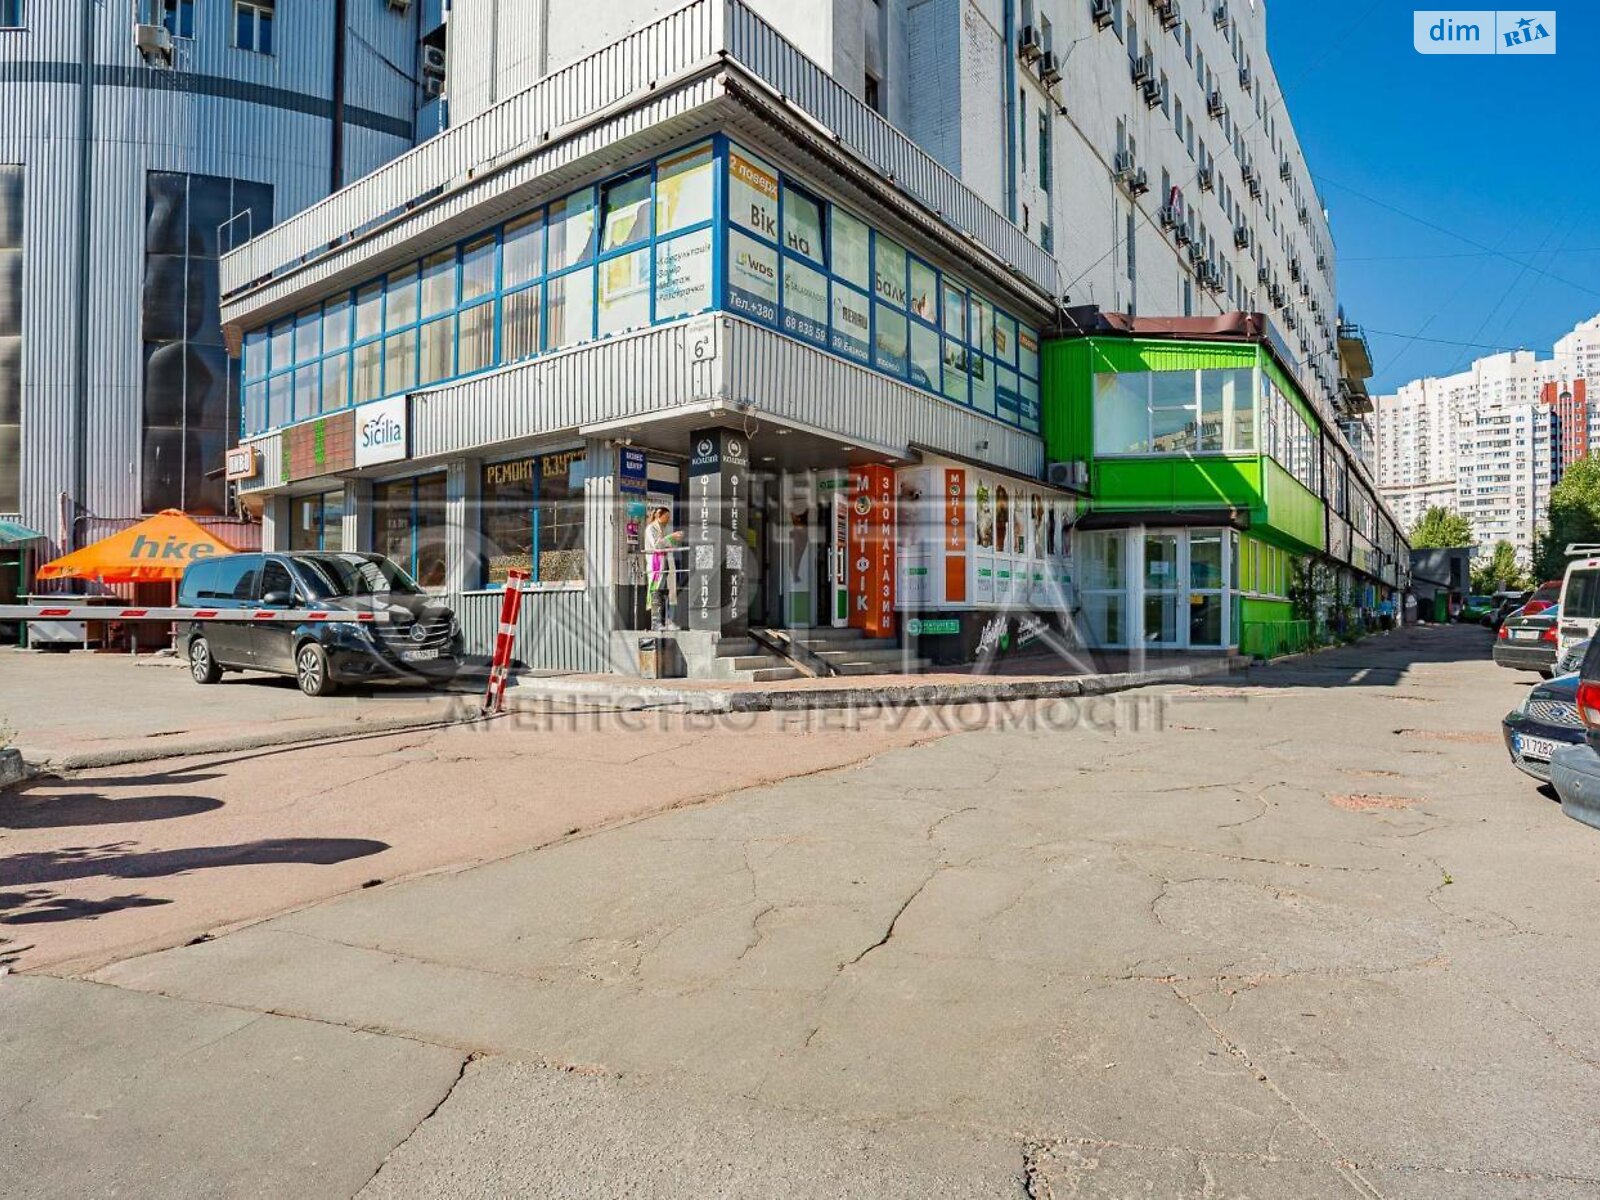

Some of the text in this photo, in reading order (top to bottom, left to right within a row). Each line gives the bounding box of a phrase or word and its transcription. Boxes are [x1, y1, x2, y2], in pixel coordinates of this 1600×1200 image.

[785, 315, 796, 330] 68
[362, 420, 402, 448] Sicilia
[487, 460, 534, 484] РЕМОНТ
[700, 475, 709, 618] ФІТНЕС КЛУБ
[730, 475, 739, 618] ФІТНЕС КЛУБ
[882, 477, 890, 629] ЗООМАГАЗИН
[1532, 739, 1555, 756] 7282
